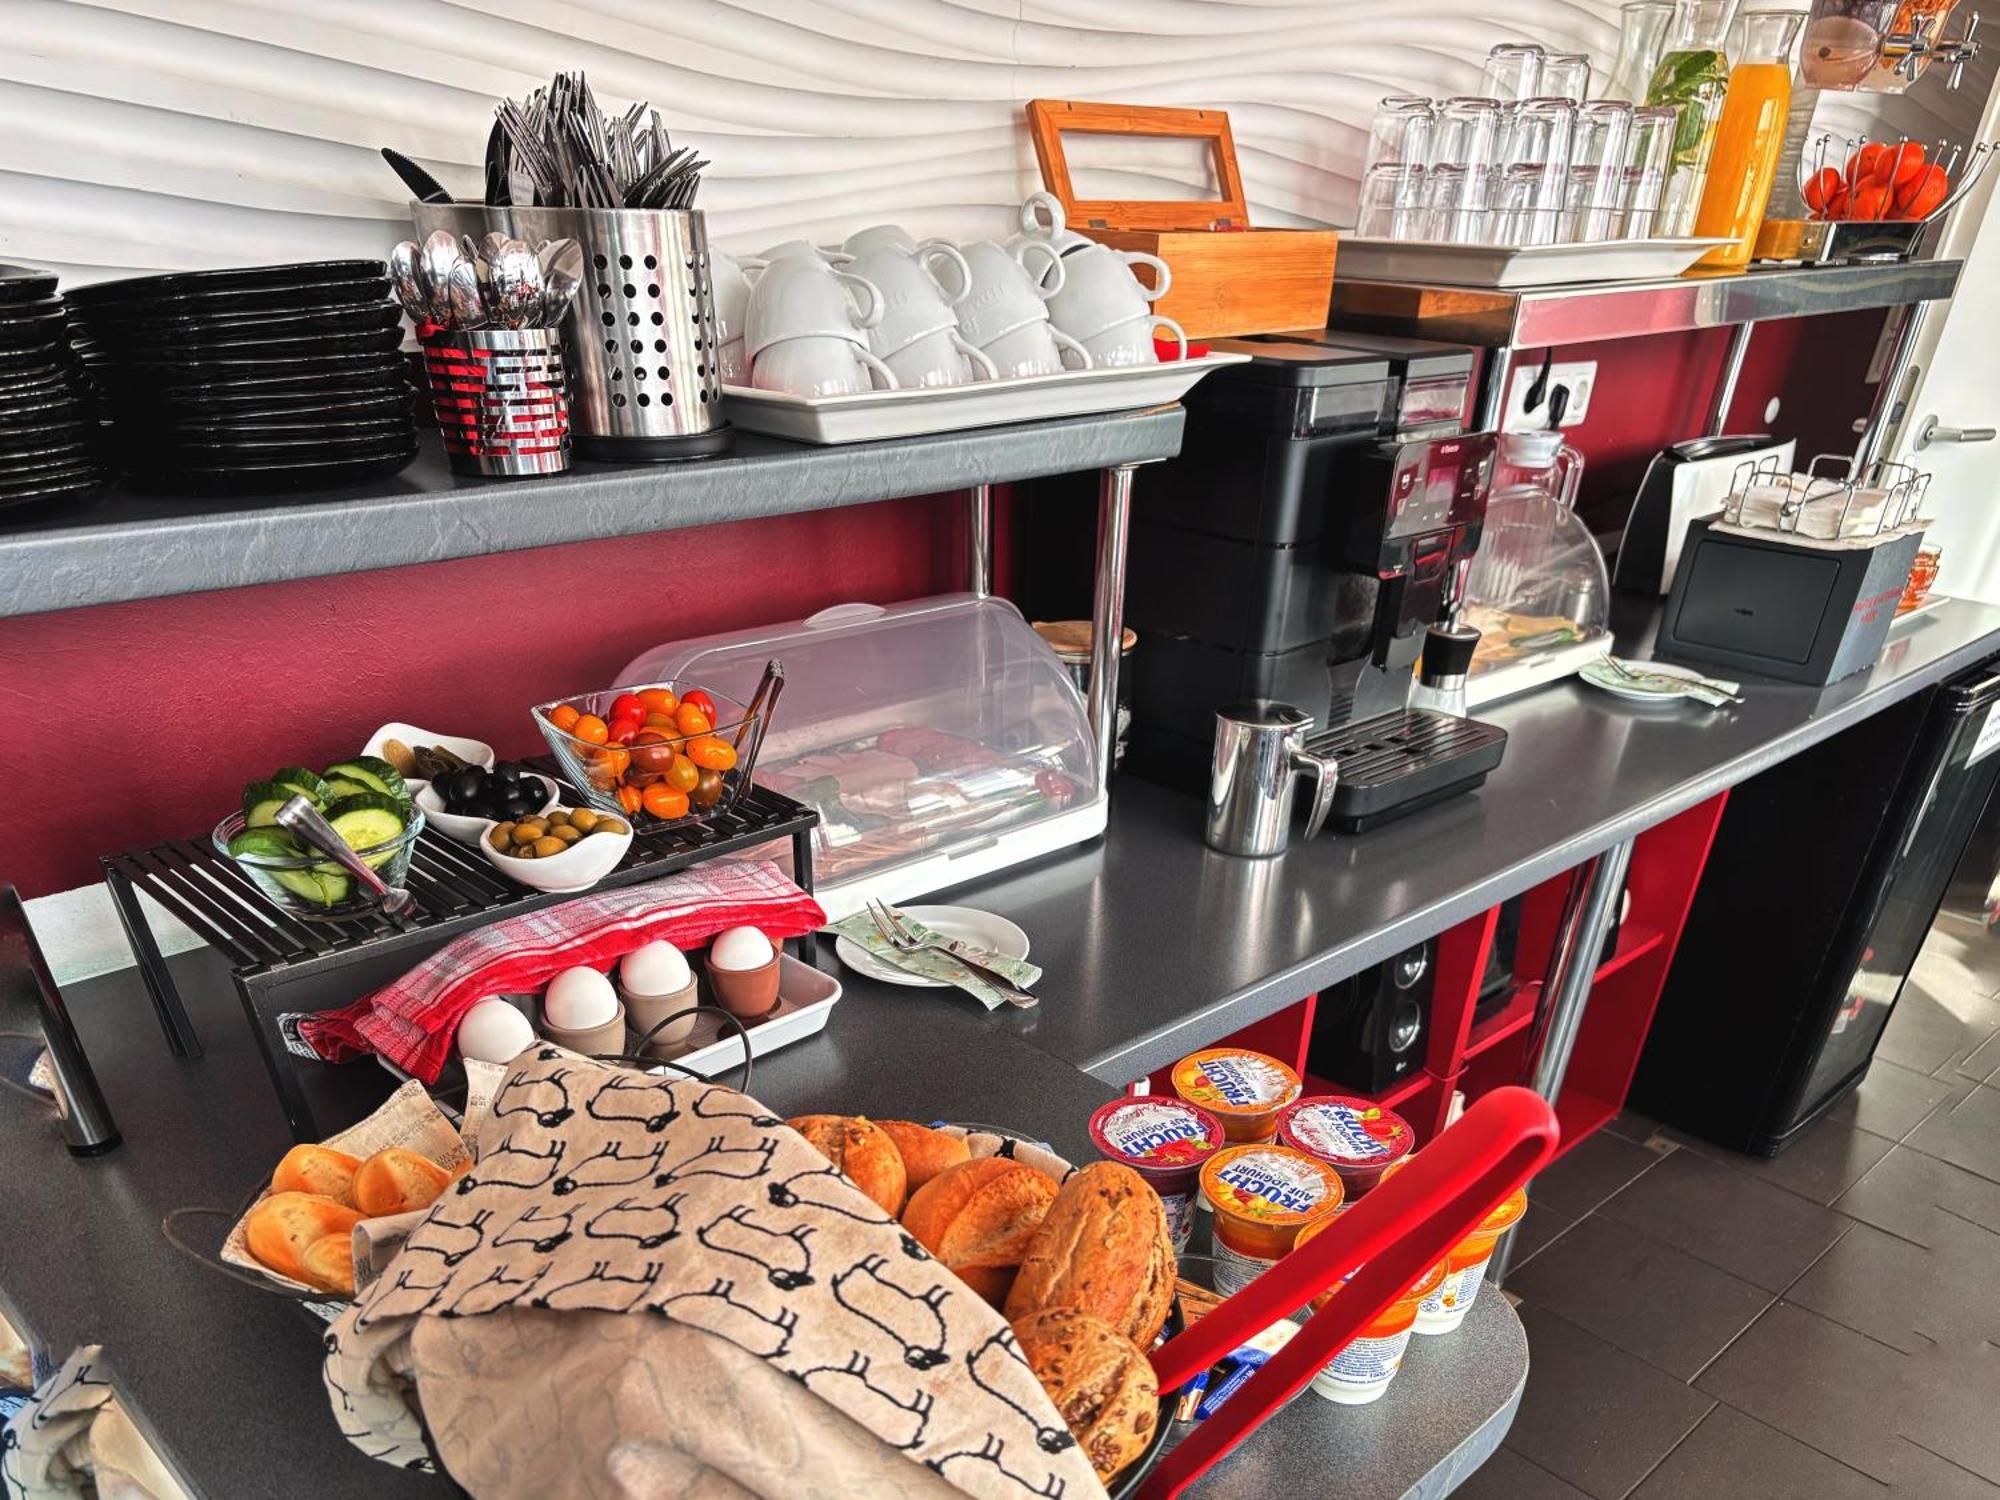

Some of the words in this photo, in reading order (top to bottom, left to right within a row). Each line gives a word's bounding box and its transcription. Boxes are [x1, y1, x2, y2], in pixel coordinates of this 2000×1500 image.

[1197, 1059, 1249, 1106] FRUCHT
[1118, 1121, 1169, 1146] JOGHURT
[1169, 1117, 1190, 1127] AUF
[1327, 1103, 1390, 1155] FRUCHT
[1121, 1119, 1208, 1158] FRUCHT
[1214, 1170, 1313, 1214] FRUCHT
[1231, 1164, 1290, 1190] JOGHURT
[1287, 1186, 1315, 1202] AUF
